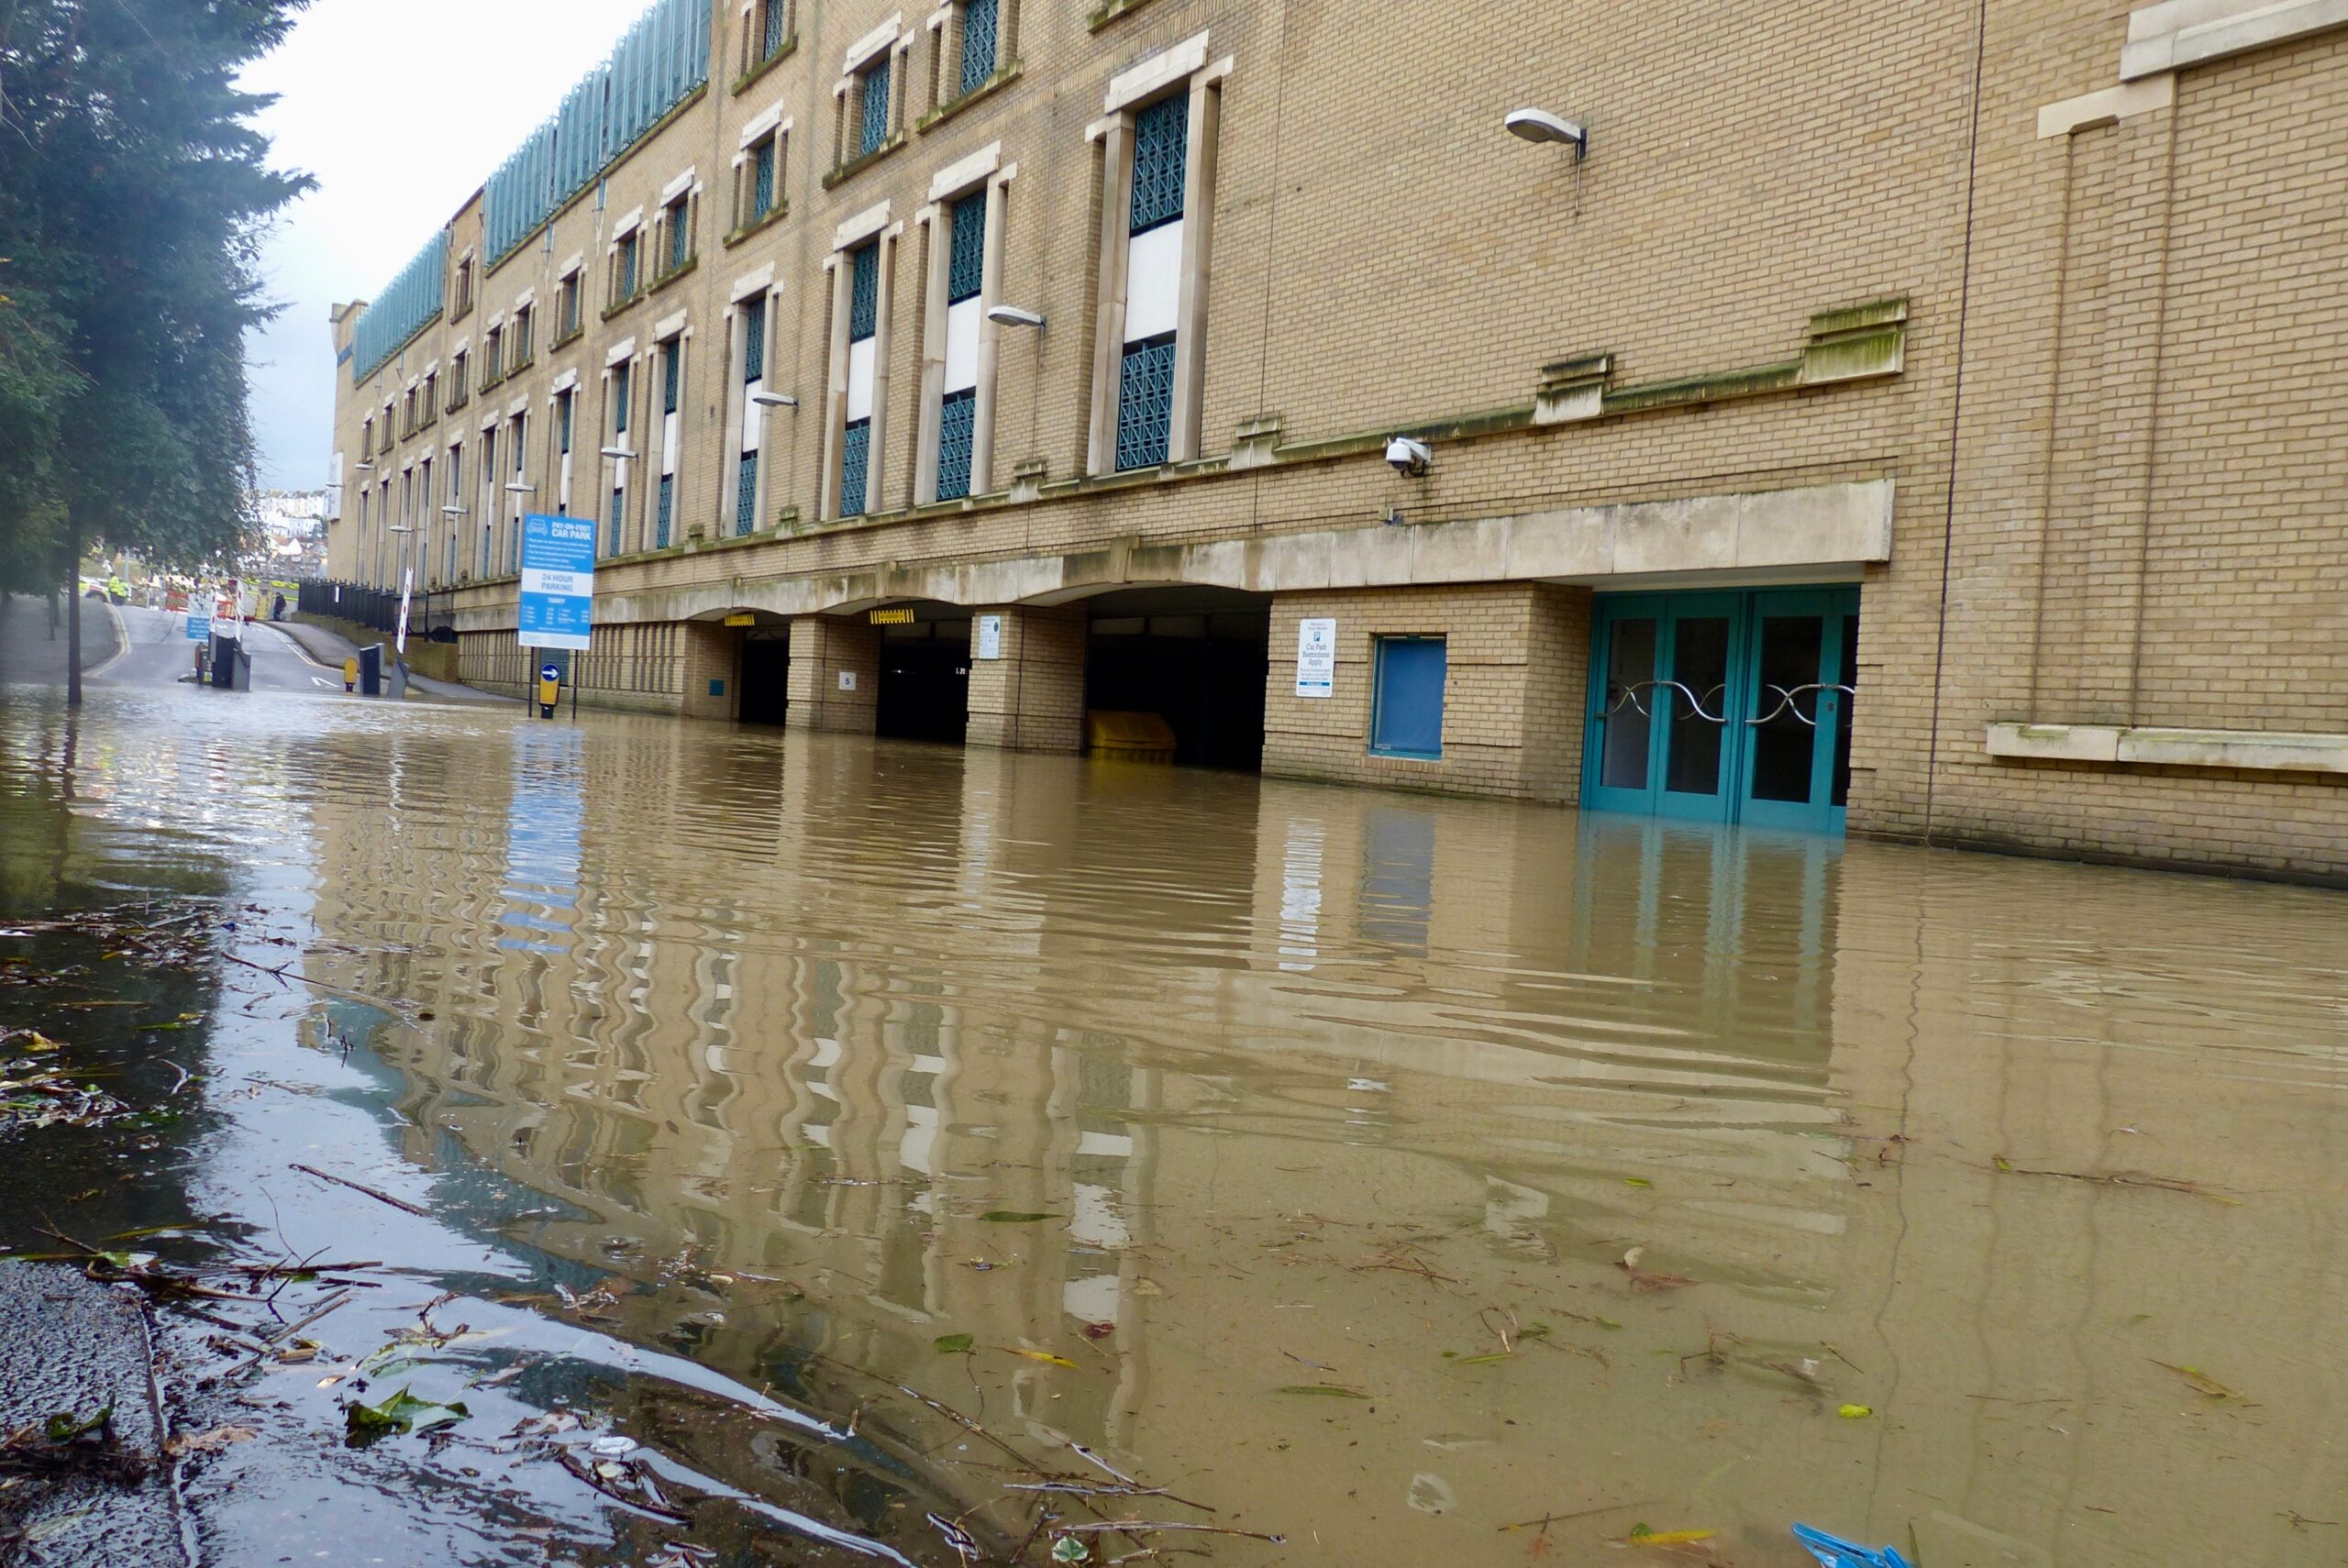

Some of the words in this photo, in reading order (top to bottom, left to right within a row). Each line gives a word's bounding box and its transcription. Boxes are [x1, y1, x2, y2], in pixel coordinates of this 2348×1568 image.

[551, 528, 569, 539] CAR
[570, 530, 592, 541] PARK
[542, 573, 551, 581] 24
[552, 574, 573, 583] HOUR
[541, 582, 573, 591] PARKING
[1309, 658, 1323, 668] Apply
[845, 678, 850, 686] 5
